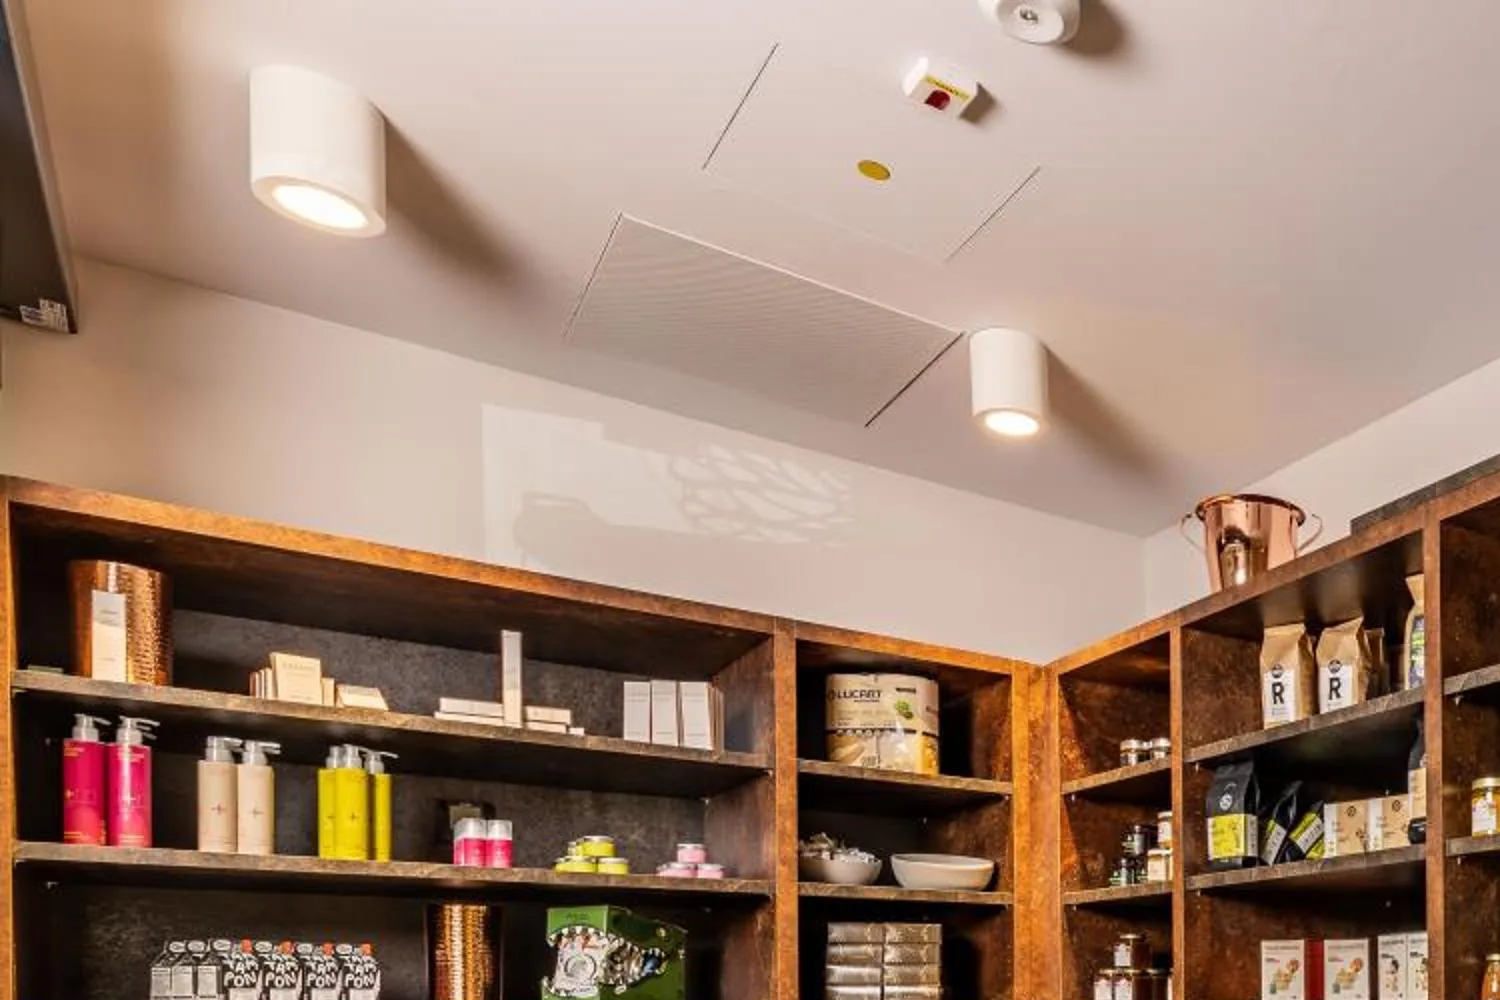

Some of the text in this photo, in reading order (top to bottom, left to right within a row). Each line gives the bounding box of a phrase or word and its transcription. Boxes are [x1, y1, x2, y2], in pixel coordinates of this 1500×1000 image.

[838, 689, 881, 699] LUCART
[1272, 682, 1285, 704] R
[1328, 677, 1341, 700] R
[224, 972, 257, 987] PON
[265, 972, 297, 987] PON
[307, 972, 337, 987] PON
[345, 973, 375, 988] PON
